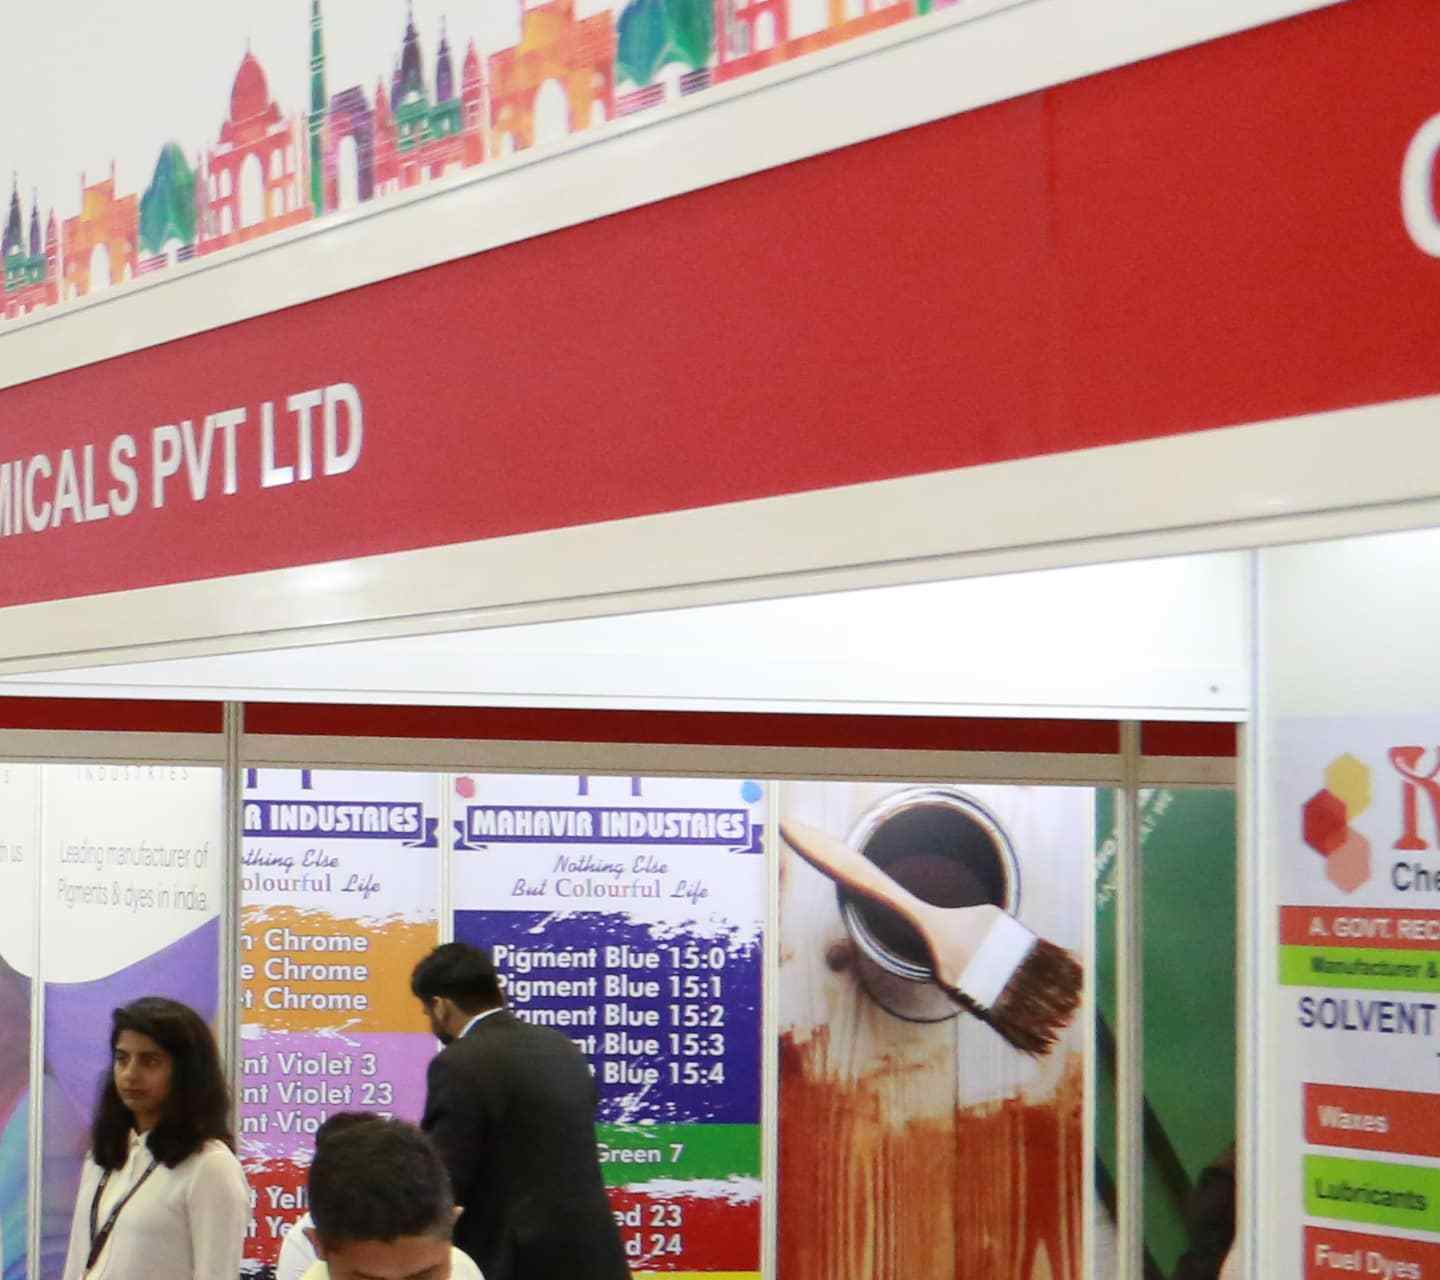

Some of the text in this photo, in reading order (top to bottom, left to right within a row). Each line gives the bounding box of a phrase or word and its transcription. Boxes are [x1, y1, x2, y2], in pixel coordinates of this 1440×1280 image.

[152, 406, 247, 512] PVT
[258, 382, 362, 489] LTD
[271, 804, 418, 833] INDUSTRIES
[472, 809, 745, 839] MAHAVIR INDUSTRIES
[302, 849, 339, 868] Else
[553, 855, 668, 879] Nothing Else
[341, 874, 381, 899] Life
[512, 877, 709, 905] But Colourful Life
[264, 928, 368, 952] Chrome
[264, 958, 368, 981] Chrome
[492, 944, 725, 974] Pigment Blue 15:0
[264, 987, 368, 1009] Chrome
[605, 975, 722, 998] Blue 15:1
[605, 1004, 725, 1027] Blue 15:2
[1298, 996, 1437, 1036] SOLVENT
[604, 1034, 725, 1056] Blue 15:3
[278, 1052, 377, 1076] Violet 3
[604, 1062, 725, 1085] Blue 15:4
[278, 1082, 393, 1105] Violet 23
[1317, 1105, 1389, 1133] Waxes
[597, 1143, 684, 1163] Green 7
[1315, 1178, 1426, 1211] Lubricants
[650, 1205, 682, 1228] 23
[650, 1234, 683, 1256] 24
[1315, 1244, 1362, 1272] Fuel
